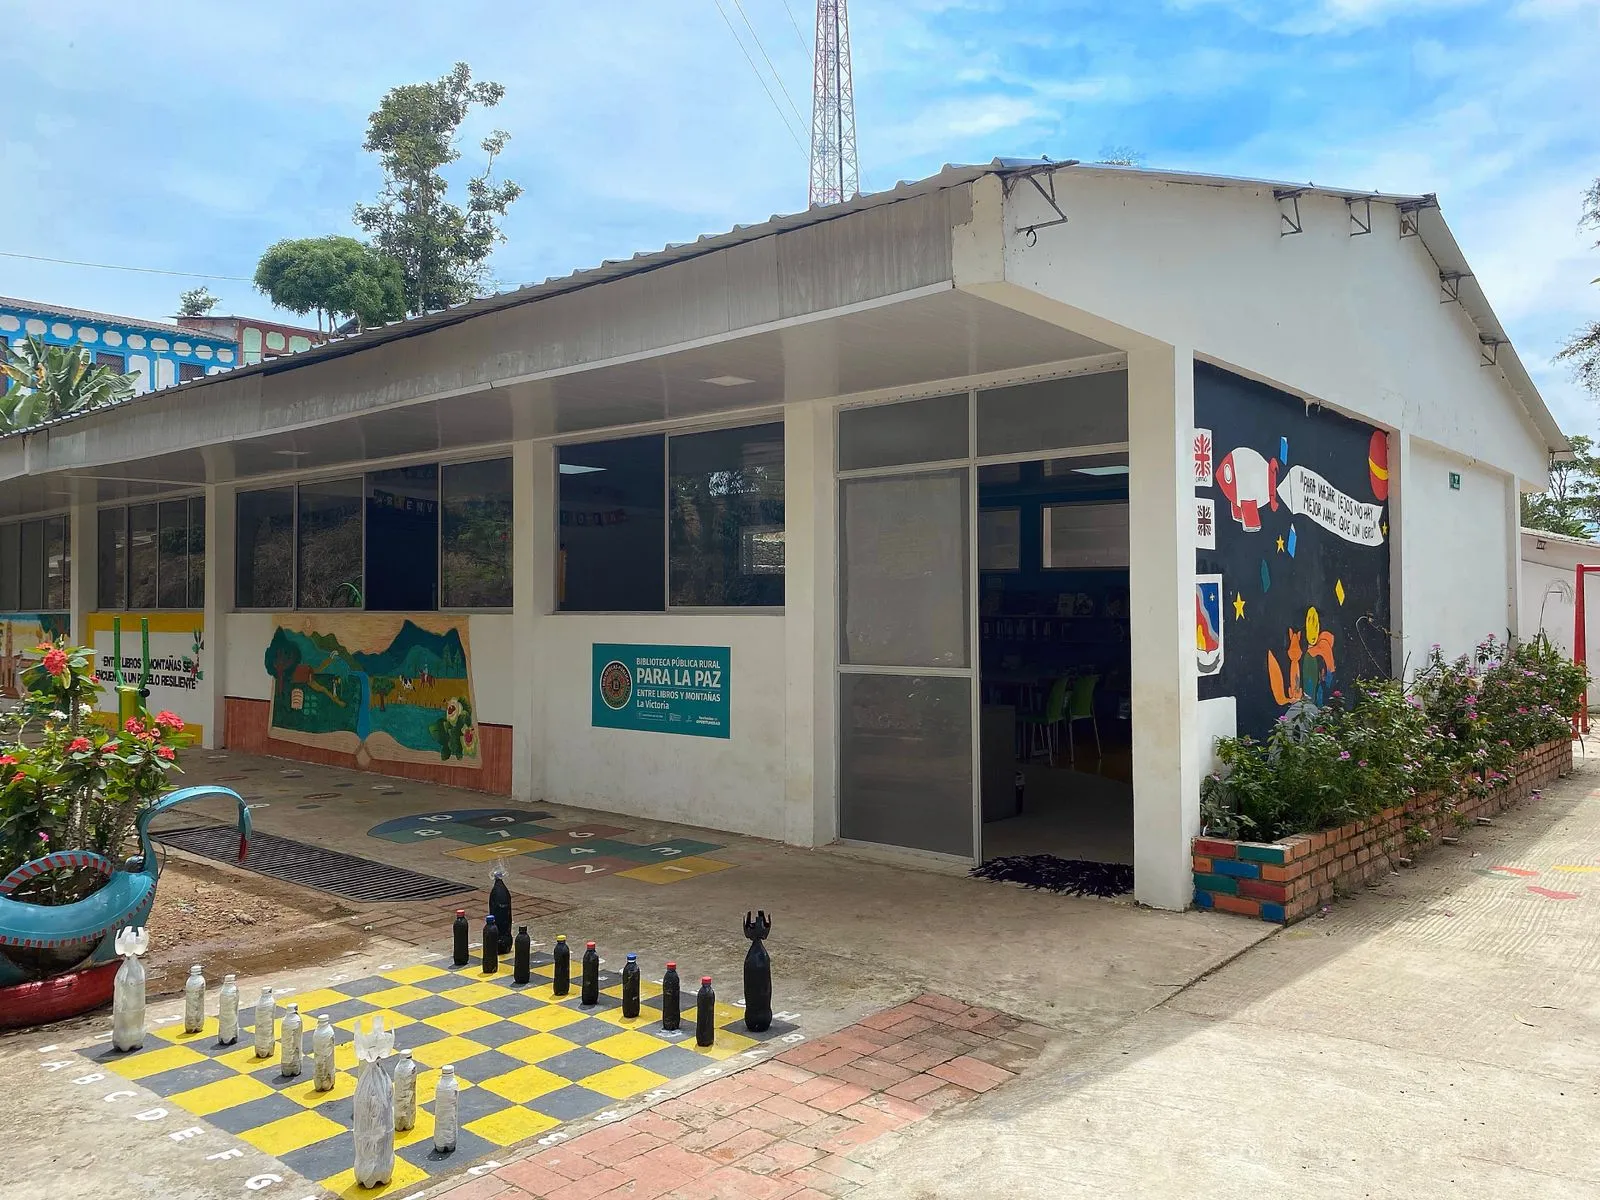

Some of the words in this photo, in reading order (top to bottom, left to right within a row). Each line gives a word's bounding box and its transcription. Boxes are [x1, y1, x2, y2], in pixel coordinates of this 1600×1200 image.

[1337, 494, 1353, 516] LEJOS
[1354, 504, 1363, 519] NO
[1363, 505, 1374, 521] HAY
[1303, 495, 1321, 517] MEJOR
[1322, 507, 1336, 526] NAVE
[1339, 515, 1350, 535] QUE
[1352, 524, 1360, 537] UN
[122, 657, 141, 668] LIBROS
[636, 657, 671, 667] BIBLIOTECA
[671, 656, 698, 668] PÚBLICA
[699, 659, 721, 669] RURAL
[128, 672, 137, 683] UN
[636, 667, 671, 685] PARA
[674, 669, 692, 686] LA
[695, 670, 721, 688] PAZ
[637, 689, 656, 698] ENTRE
[657, 690, 679, 700] LIBROS
[680, 691, 685, 700] Y
[685, 691, 721, 702] MONTAÑAS
[636, 700, 644, 708] La
[645, 699, 670, 710] Victoria
[418, 814, 453, 822] 10
[413, 828, 443, 837] 8
[485, 829, 511, 838] 7
[487, 845, 518, 853] 5
[570, 847, 597, 855] 4
[650, 847, 682, 856] 3
[568, 864, 607, 874] 2
[40, 1059, 76, 1072] A
[72, 1072, 106, 1085] B
[103, 1090, 138, 1102] C
[466, 1160, 501, 1175] 2
[537, 1132, 569, 1145] 3
[781, 1033, 806, 1043] 8
[131, 1107, 169, 1121] D
[168, 1126, 206, 1142] E
[205, 1148, 244, 1160] F
[244, 1173, 284, 1190] G
